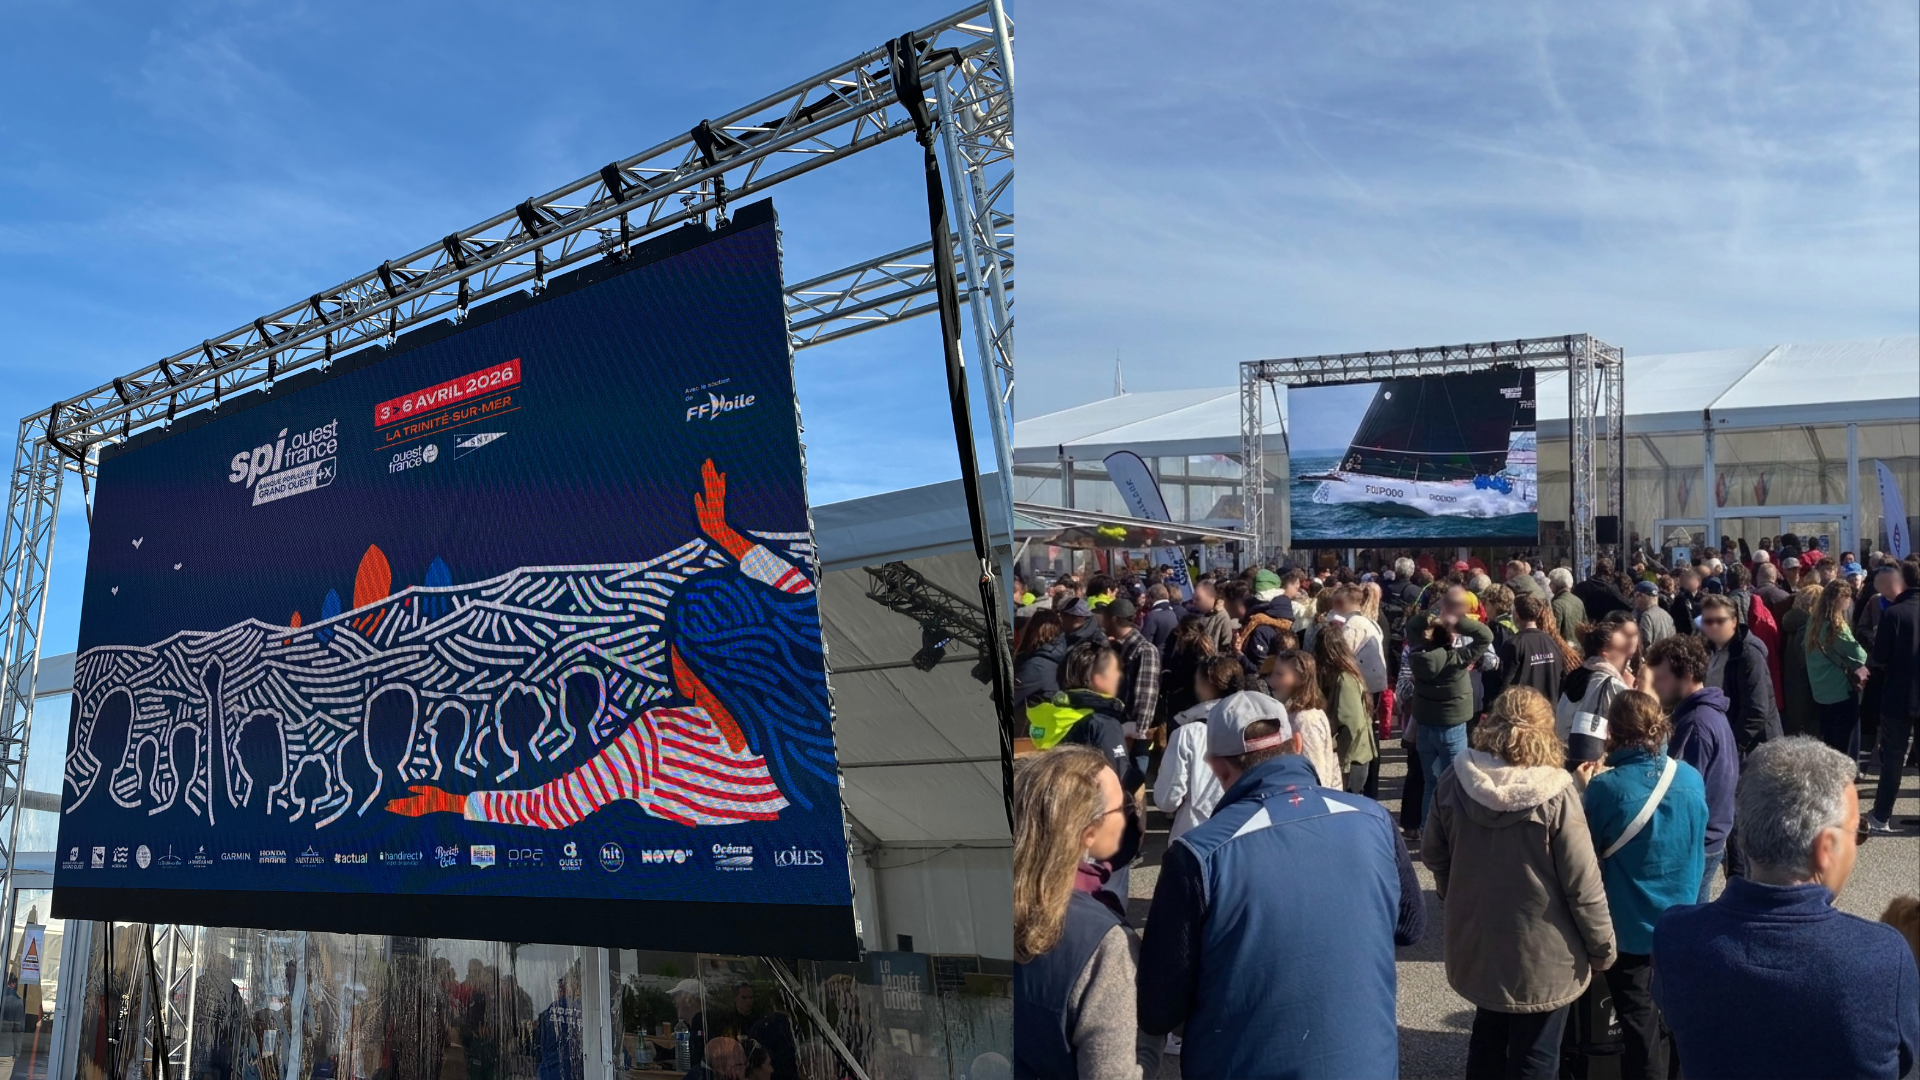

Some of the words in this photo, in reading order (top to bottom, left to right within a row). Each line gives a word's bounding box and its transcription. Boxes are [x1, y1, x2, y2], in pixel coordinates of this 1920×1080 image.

[380, 406, 391, 420] 3
[402, 399, 413, 413] 6
[415, 384, 464, 409] AVRIL
[465, 366, 514, 394] 2026
[685, 386, 700, 394] Avec
[386, 429, 402, 442] LA
[403, 395, 512, 437] TRINITÉ-SUR-MER
[291, 417, 338, 450] ouest
[229, 427, 288, 489] spi
[284, 438, 338, 468] france
[392, 445, 422, 463] ouest
[389, 456, 423, 474] france
[259, 484, 287, 499] GRAND
[287, 475, 314, 493] OUEST
[221, 852, 251, 861] GARMIN
[385, 851, 419, 860] handirect
[435, 844, 459, 859] Breizh
[603, 847, 620, 860] hit
[712, 843, 753, 855] Océane
[295, 856, 310, 865] SAINT
[341, 853, 368, 864] actual
[440, 857, 457, 868] Cola
[880, 960, 891, 974] LA
[881, 970, 921, 993] MARÉE
[882, 991, 923, 1011] DOUCE
